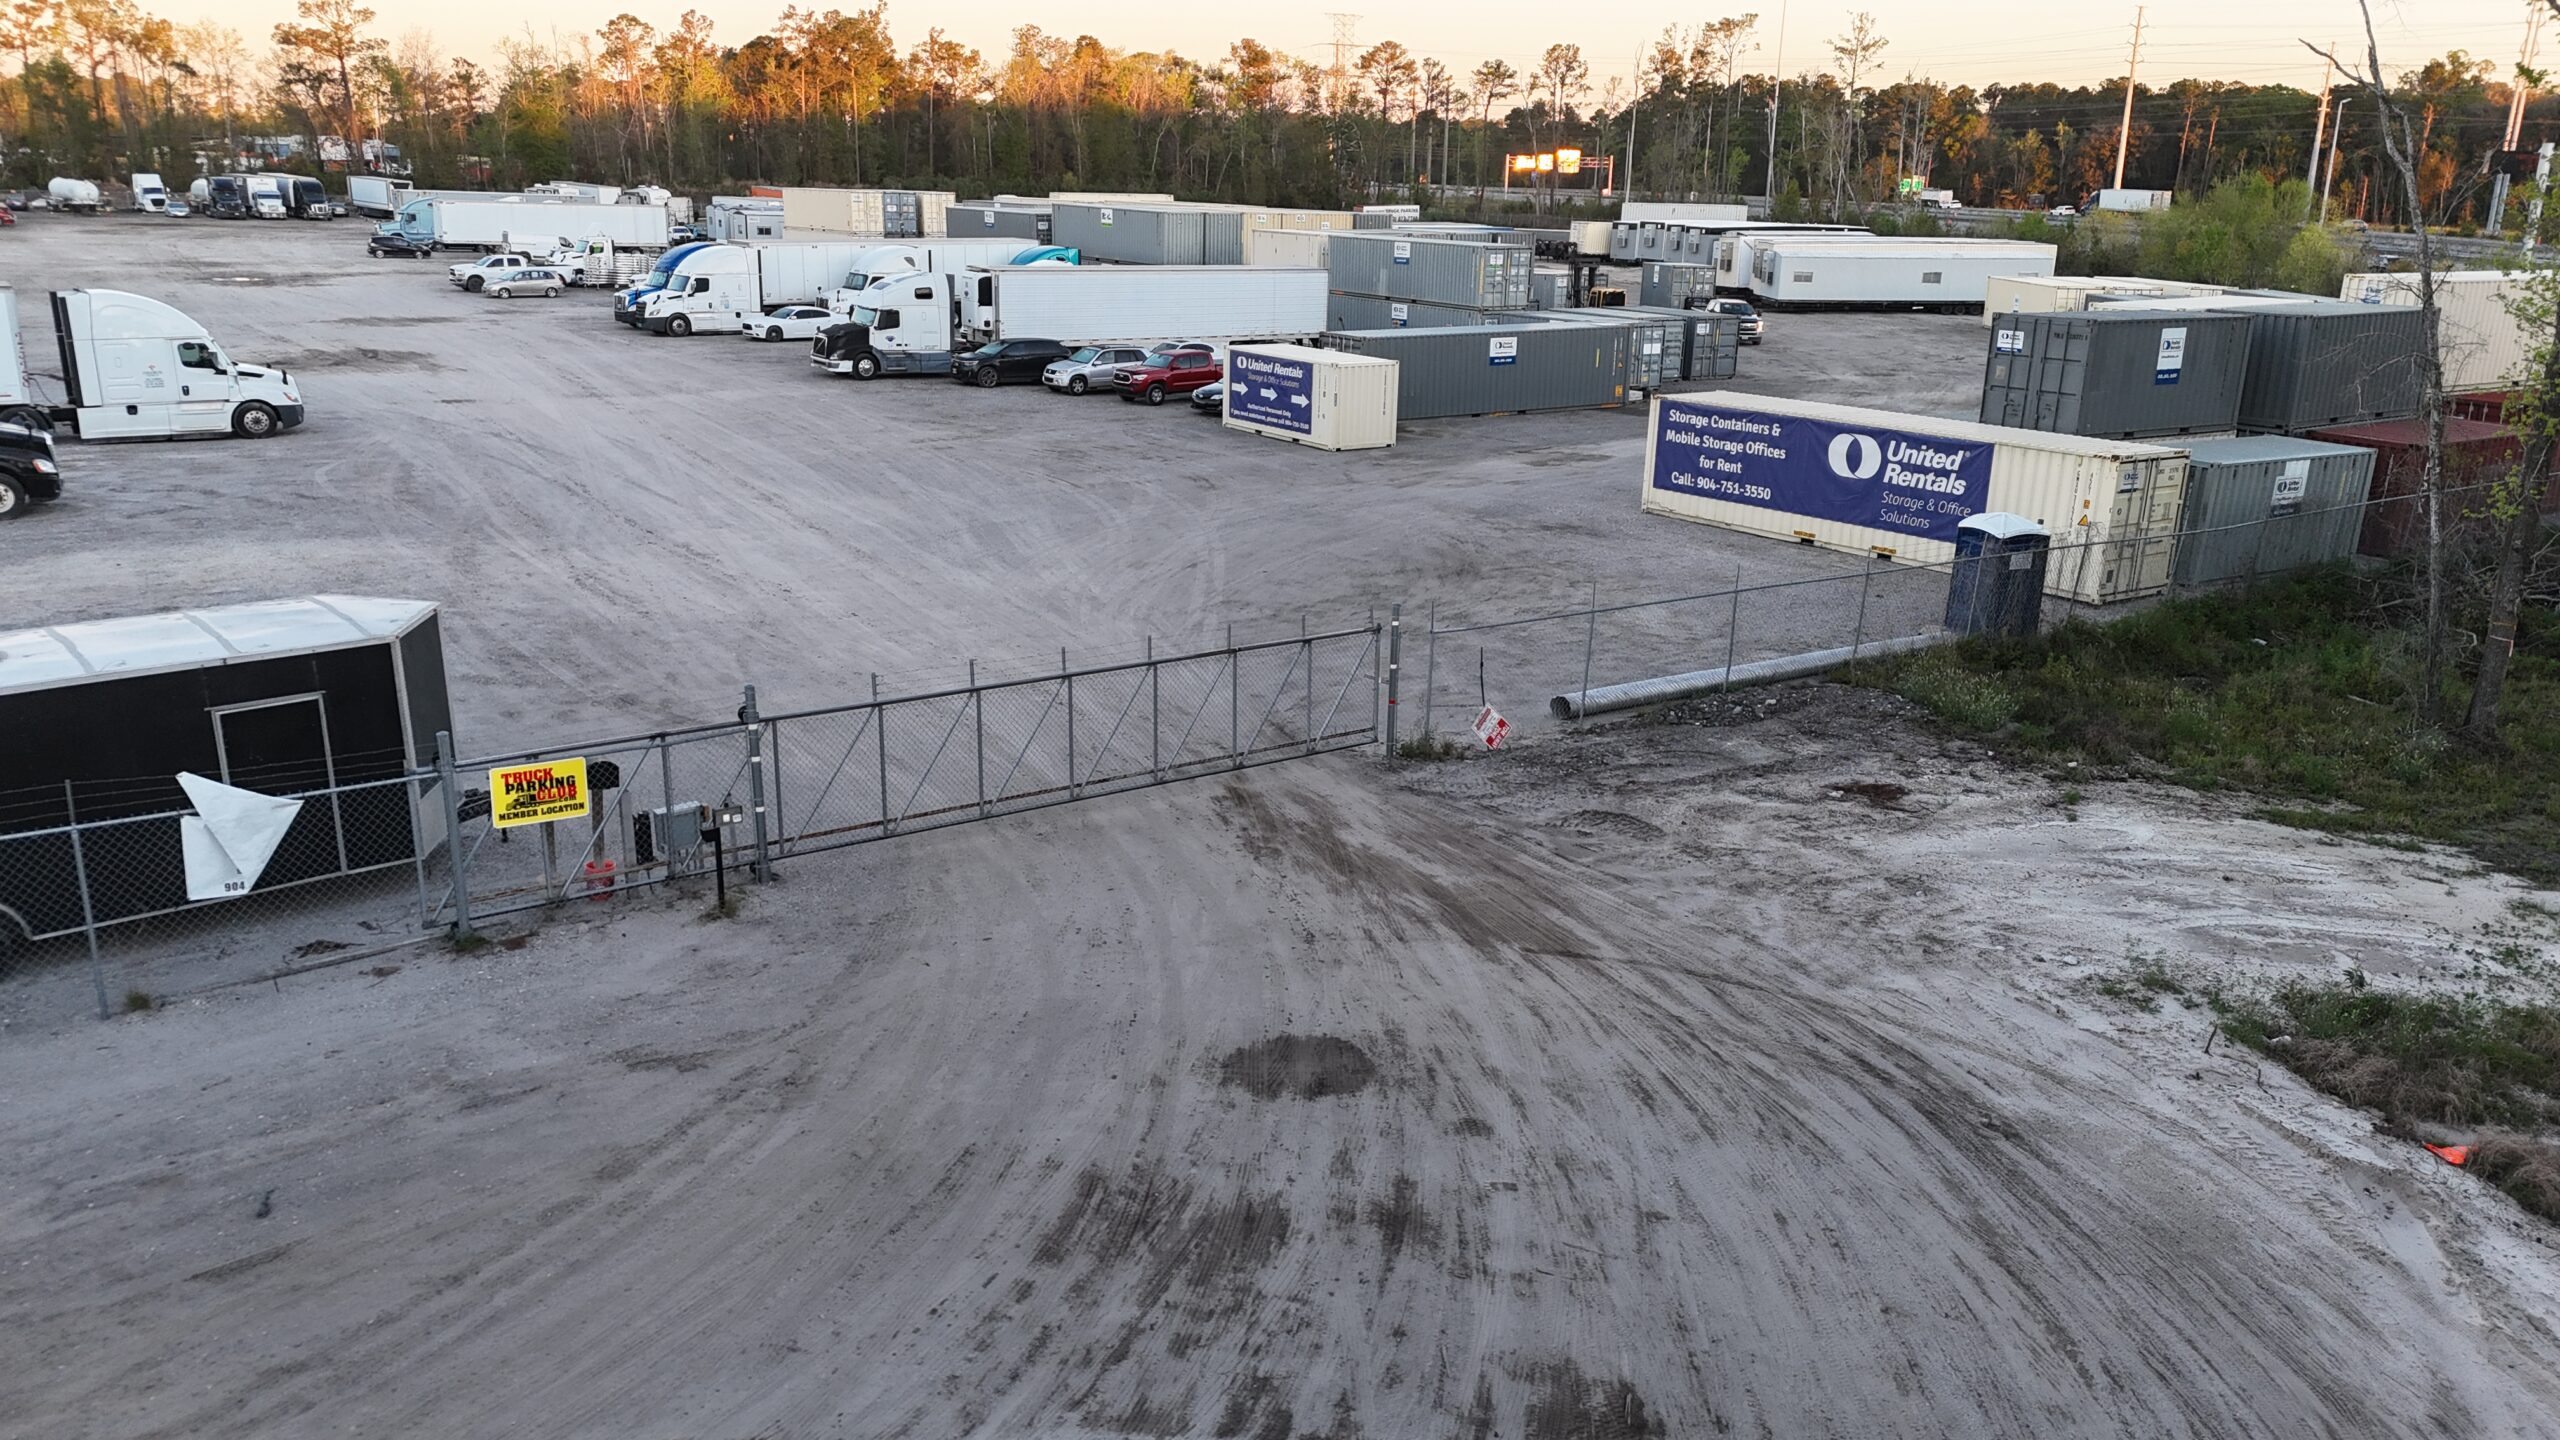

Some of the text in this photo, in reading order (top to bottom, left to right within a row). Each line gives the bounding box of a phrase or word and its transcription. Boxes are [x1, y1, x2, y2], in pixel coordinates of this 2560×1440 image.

[1248, 357, 1303, 378] United Rentals
[1669, 409, 1781, 436] Storage Containers &
[1666, 429, 1786, 459] Mobile Storage Offices
[1699, 455, 1742, 474] for Rent
[1887, 440, 1964, 470] United
[1671, 472, 1771, 500] Call: 904-751-3550
[1883, 463, 1967, 495] Rentals
[1881, 491, 1971, 517] Storage & Office
[1880, 508, 1930, 529] Solutions
[501, 768, 553, 785] TRUCK
[505, 775, 576, 795] PARKING
[536, 784, 577, 801] CLUB
[499, 802, 585, 821] MEMBER LOCATION
[225, 881, 246, 892] 904
